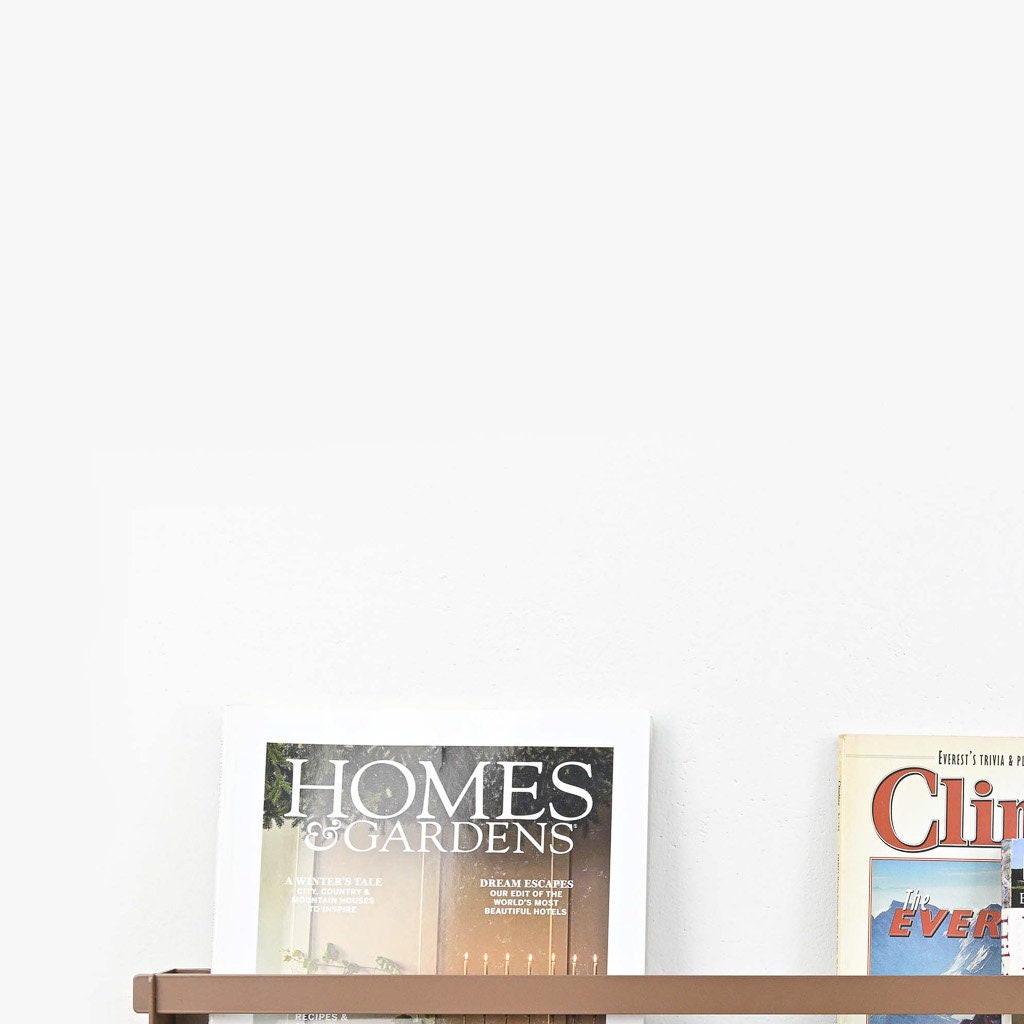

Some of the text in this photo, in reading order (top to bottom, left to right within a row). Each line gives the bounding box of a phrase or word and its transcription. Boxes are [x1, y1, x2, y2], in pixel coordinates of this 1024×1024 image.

[938, 750, 976, 765] EVEREST'S
[980, 753, 1005, 766] TRIVIA
[1008, 755, 1013, 766] &
[284, 758, 594, 822] HOMES
[284, 877, 384, 887] A WINTER'S TALE
[479, 879, 575, 889] DREAM ESCAPES
[321, 888, 361, 896] COUNTRY
[532, 890, 545, 898] OF
[545, 890, 563, 898] THE
[291, 896, 375, 905] MOUNTAIN HOUSES
[534, 899, 560, 907] MOST
[902, 888, 931, 912] The
[484, 907, 568, 916] BEAUTIFUL HOTELS
